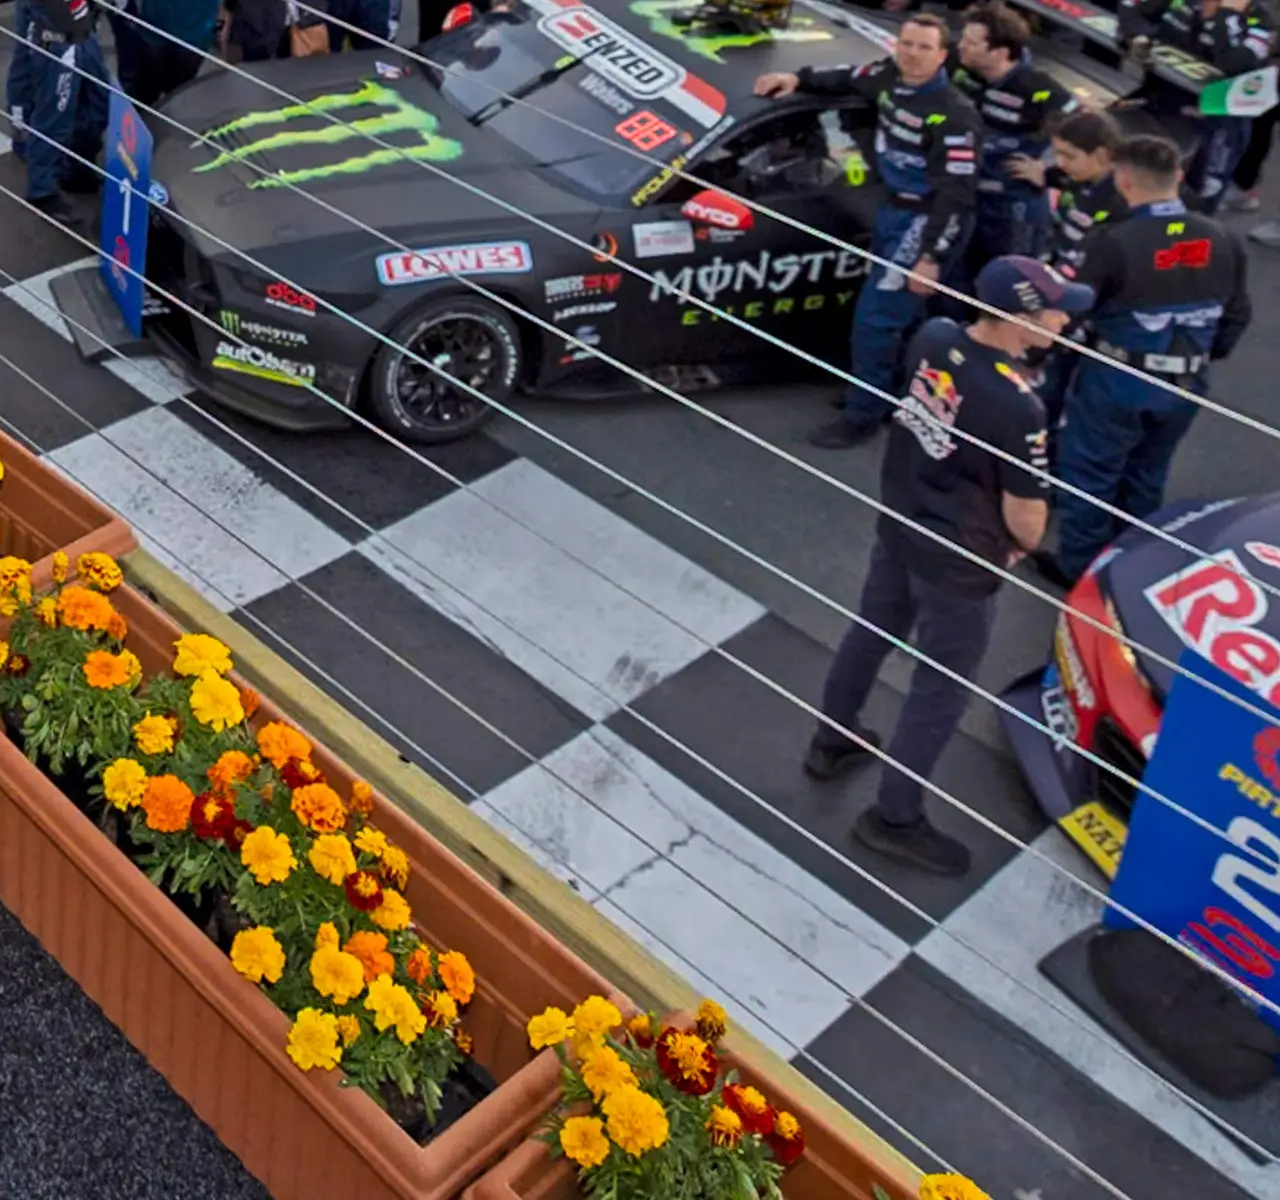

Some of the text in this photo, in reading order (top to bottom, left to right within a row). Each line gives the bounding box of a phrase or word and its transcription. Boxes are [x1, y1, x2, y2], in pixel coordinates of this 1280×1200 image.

[582, 32, 665, 85] ENZED
[390, 246, 522, 280] LOWES
[649, 250, 872, 305] MONSTE
